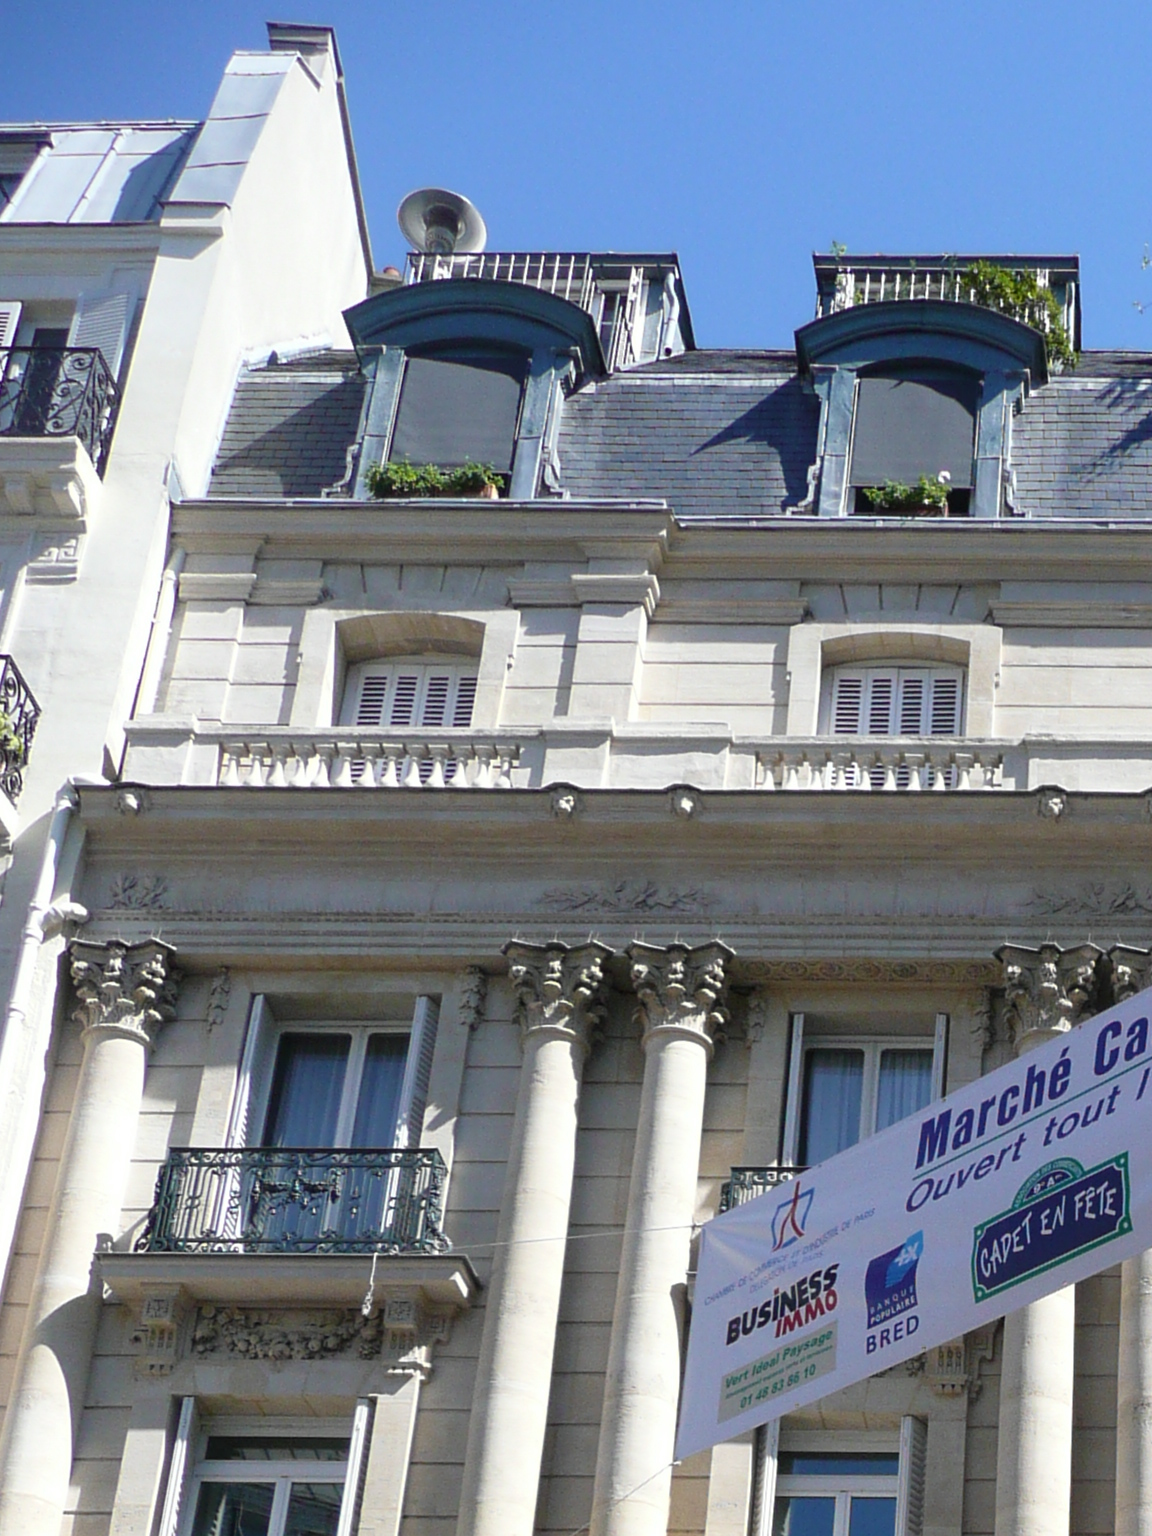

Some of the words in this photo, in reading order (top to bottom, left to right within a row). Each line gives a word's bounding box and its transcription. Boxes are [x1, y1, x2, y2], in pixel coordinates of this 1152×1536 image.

[915, 1046, 1073, 1170] Marché
[905, 1132, 1027, 1213] Ouvert
[1042, 1085, 1121, 1148] tout
[980, 1211, 1033, 1278] CADET
[1040, 1195, 1066, 1235] EN
[1073, 1180, 1117, 1222] FÊTE
[774, 1288, 839, 1339] IMMO
[868, 1286, 915, 1314] BANQUE
[869, 1294, 917, 1325] POPULAIRE
[724, 1369, 749, 1389] Vert
[751, 1353, 780, 1376] Ideal
[782, 1329, 834, 1362] Paysage
[866, 1315, 920, 1355] BRED
[739, 1395, 753, 1409] 01
[803, 1363, 817, 1379] 10
